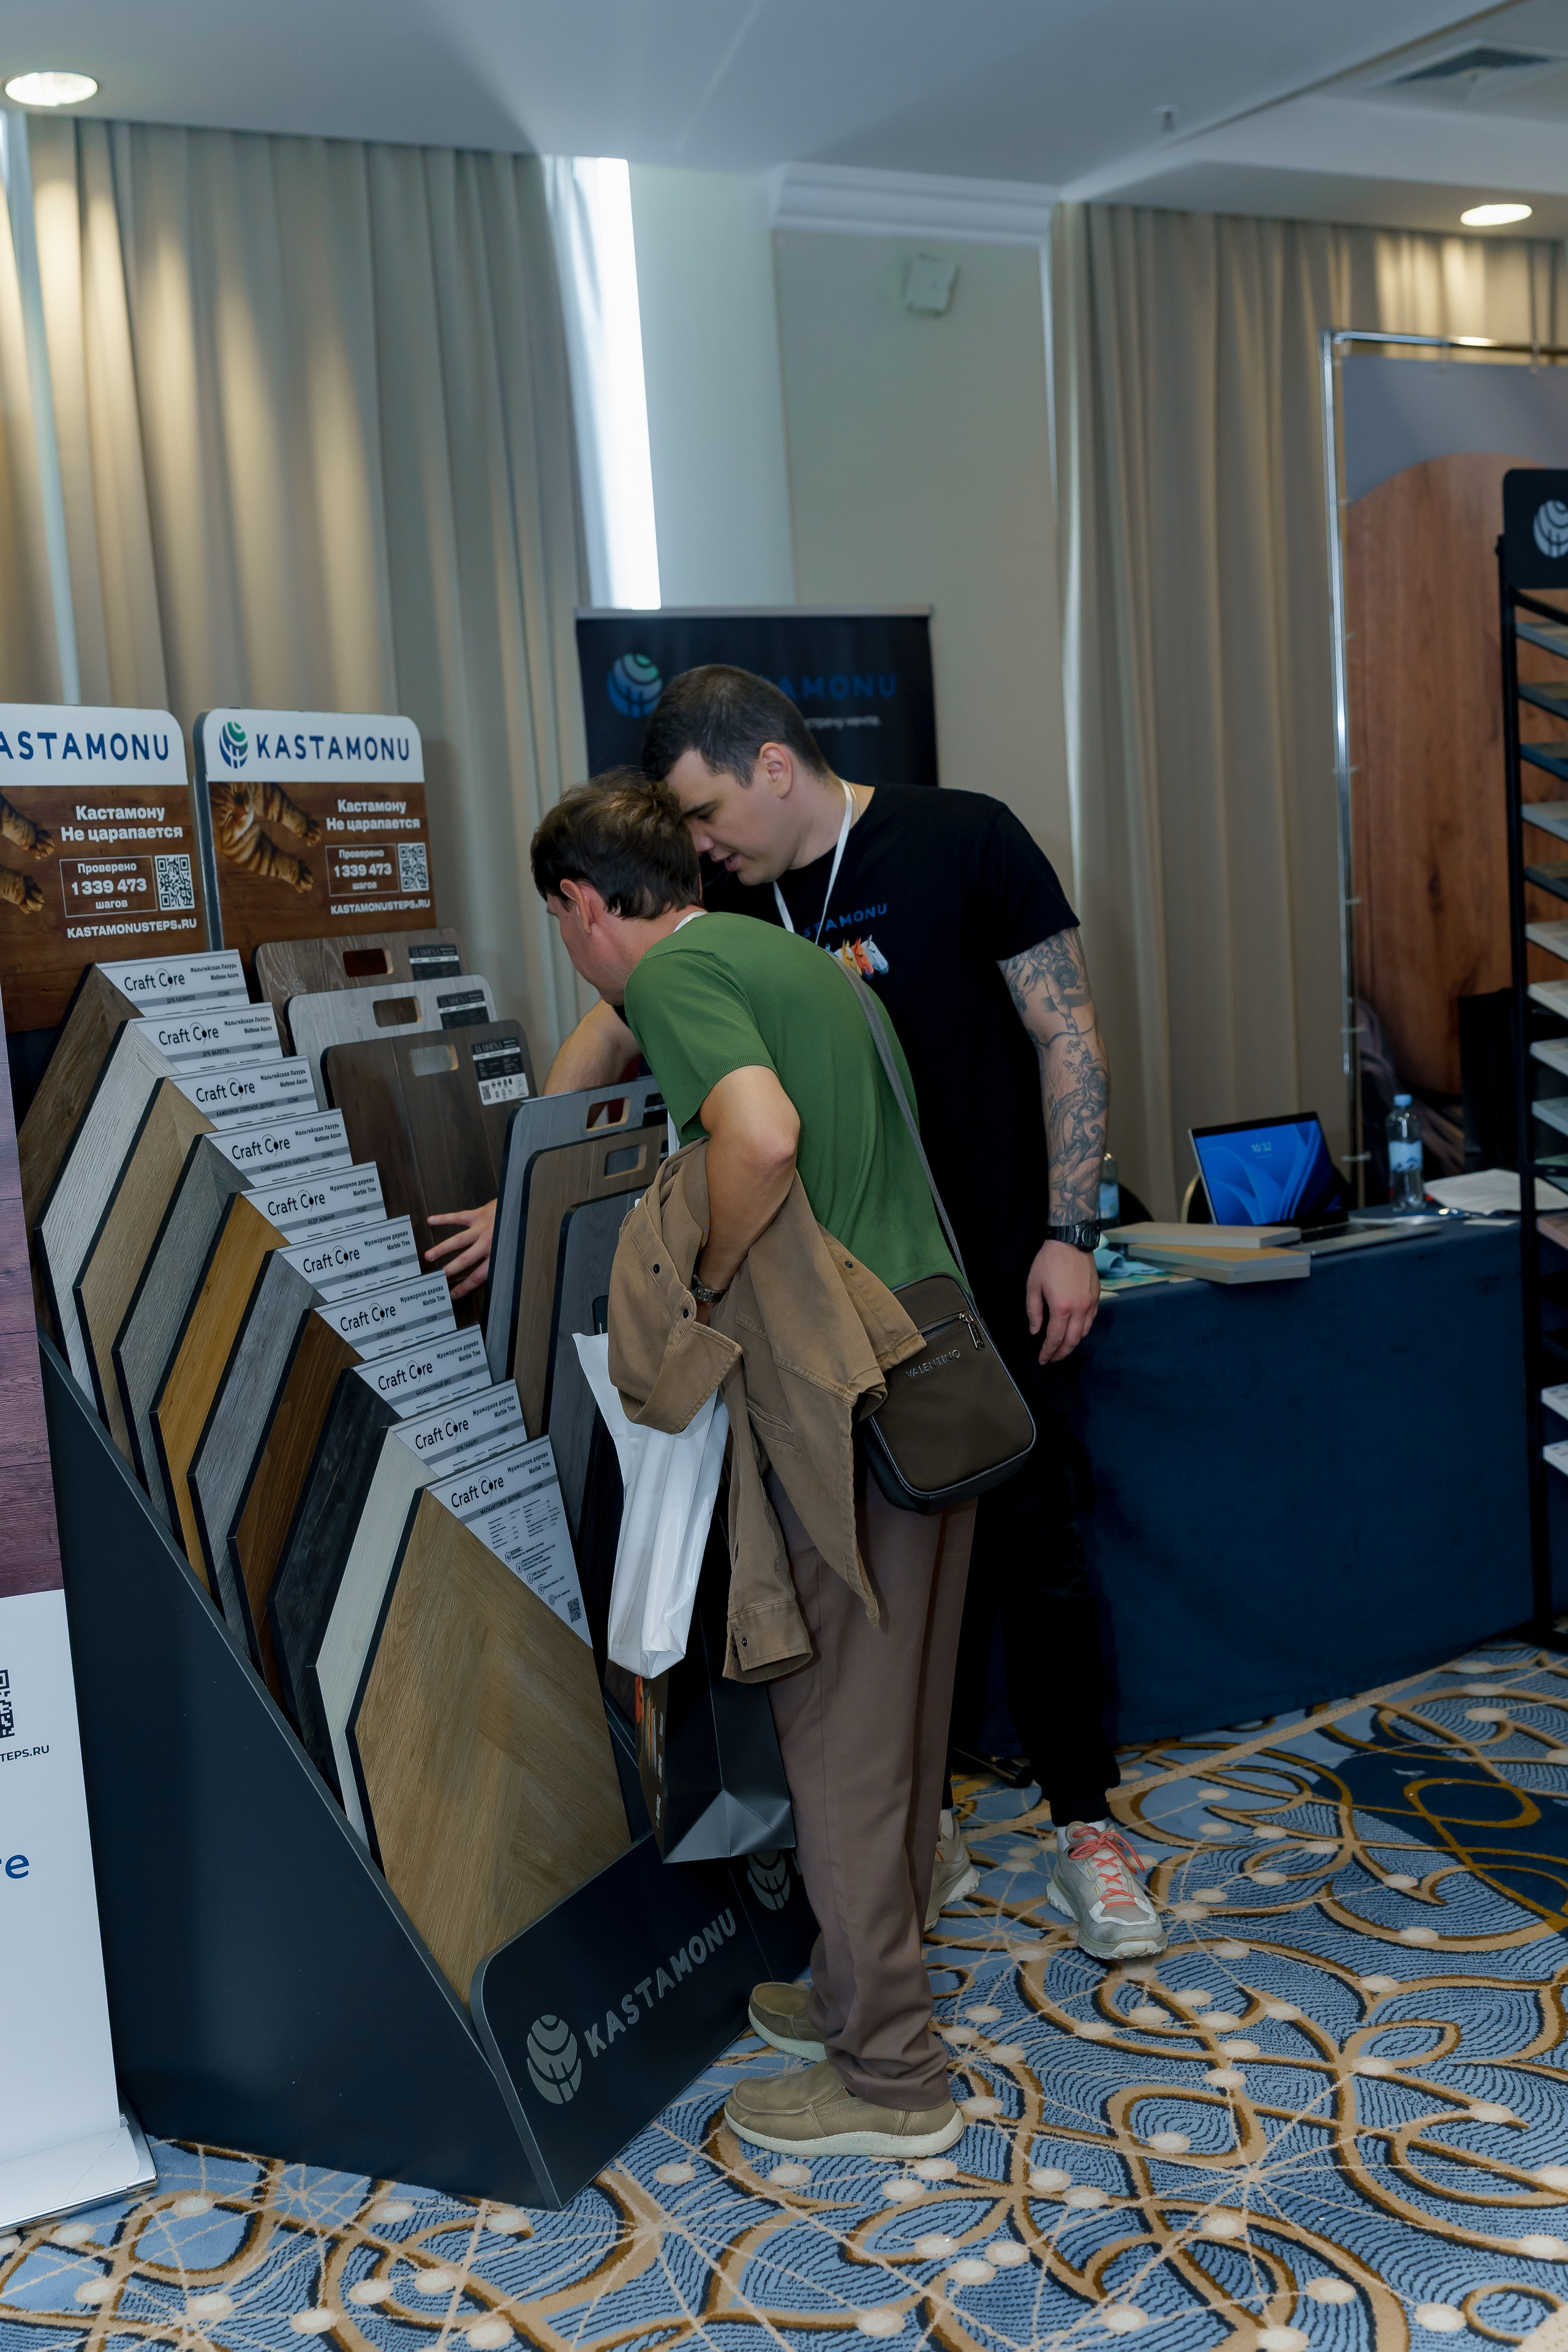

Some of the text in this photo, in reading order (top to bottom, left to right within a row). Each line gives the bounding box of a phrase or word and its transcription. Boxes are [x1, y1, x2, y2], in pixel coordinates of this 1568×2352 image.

[777, 674, 897, 699] AMONU
[256, 733, 409, 761] KASTAMONU
[75, 805, 165, 822] Кастамону
[337, 799, 407, 815] Кастамону
[326, 817, 420, 833] Не царапается
[61, 826, 183, 843] Не царапается
[339, 849, 385, 860] Проверено
[77, 862, 137, 875] Проверено
[369, 862, 392, 875] 473
[117, 878, 147, 892] 473
[352, 881, 377, 890] шагов
[95, 899, 128, 910] шагов
[331, 899, 431, 915] KASTAMONUSTEPS.RU
[67, 918, 197, 938] KASTAMONUSTEPS.RU
[798, 903, 887, 938] STAMONU
[190, 964, 221, 973] Мальтийская
[124, 974, 156, 991] Craft
[224, 1018, 254, 1027] Мальтийская
[159, 1028, 190, 1045] Craft
[260, 1072, 290, 1081] Мальтийская
[196, 1085, 227, 1102] Craft
[295, 1123, 339, 1136] Мальтийская Лазурь
[232, 1142, 263, 1159] Craft
[330, 1177, 374, 1192] Мраморное дерево
[268, 1197, 298, 1216] Craft
[364, 1231, 409, 1247] Мраморное дерево
[303, 1254, 333, 1273] Craft
[400, 1286, 444, 1303] Мраморное дерево
[340, 1311, 369, 1332] Craft
[436, 1341, 479, 1360] Мраморное дерево
[906, 1349, 960, 1378] VALENTINO
[378, 1370, 407, 1390] Craft
[472, 1395, 514, 1416] Мраморное дерево
[494, 1409, 507, 1418] Marble
[415, 1428, 443, 1450] Craft
[507, 1451, 548, 1473] Мраморное дерево
[529, 1465, 541, 1474] Marble
[451, 1485, 479, 1508] Craft
[0, 1745, 50, 1762] TEPS.RU
[584, 1908, 736, 2058] KASTAMONU
